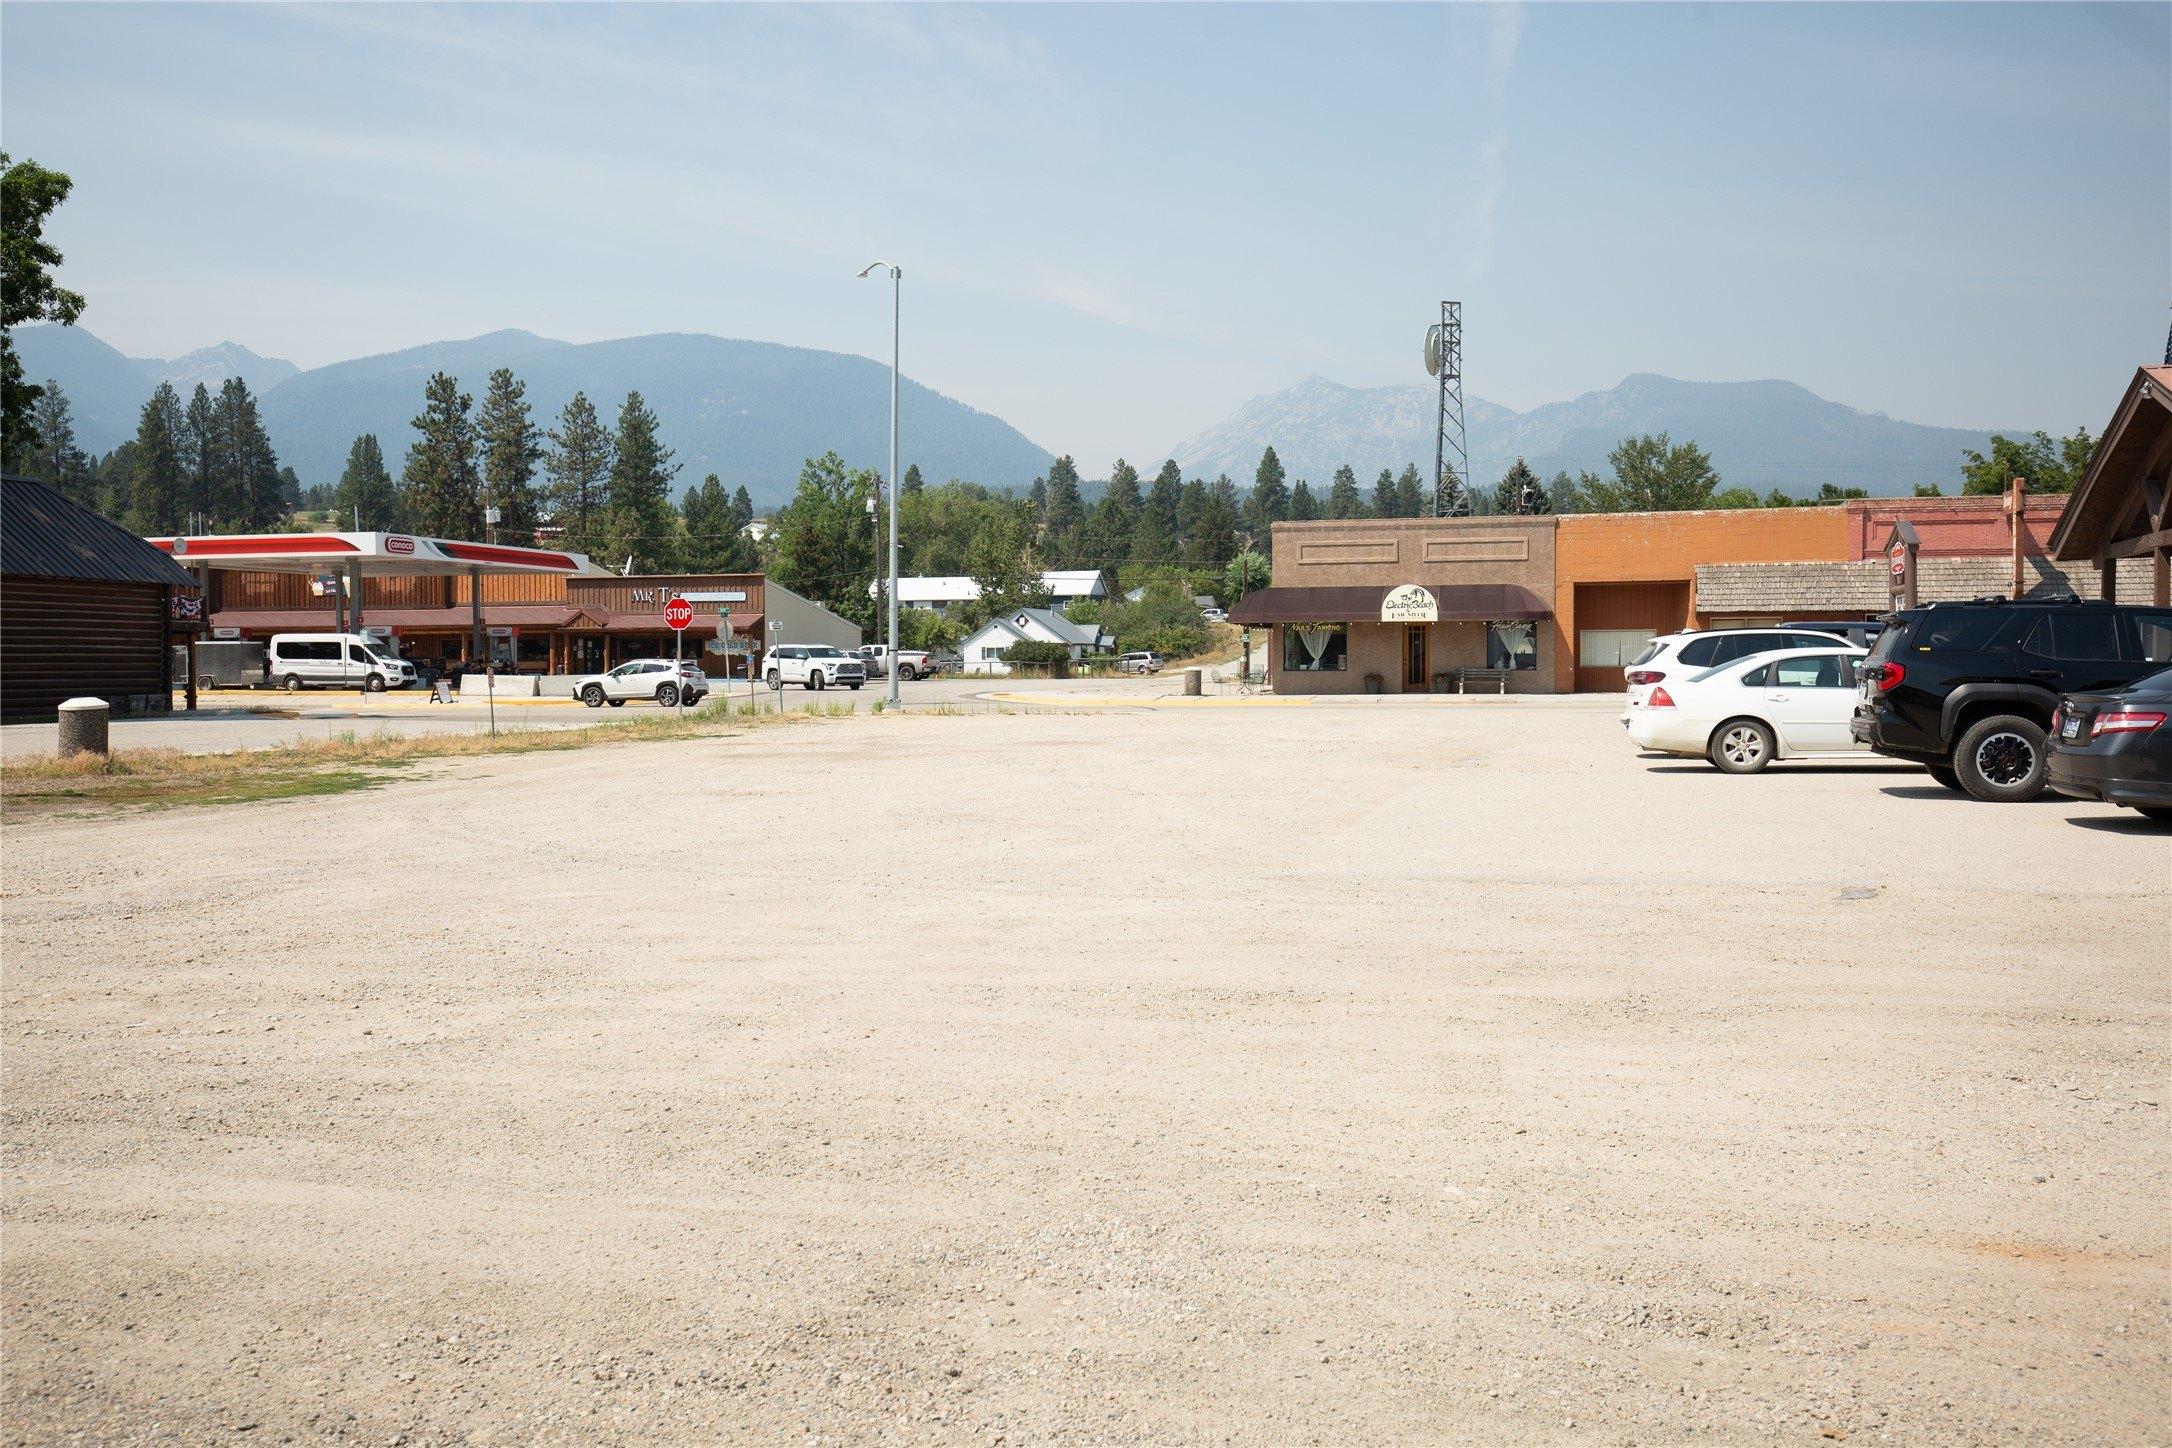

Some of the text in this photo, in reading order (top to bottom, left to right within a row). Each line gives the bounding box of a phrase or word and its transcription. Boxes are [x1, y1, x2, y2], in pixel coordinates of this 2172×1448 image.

[1386, 600, 1434, 610] Electric Beach
[666, 608, 691, 620] STOP
